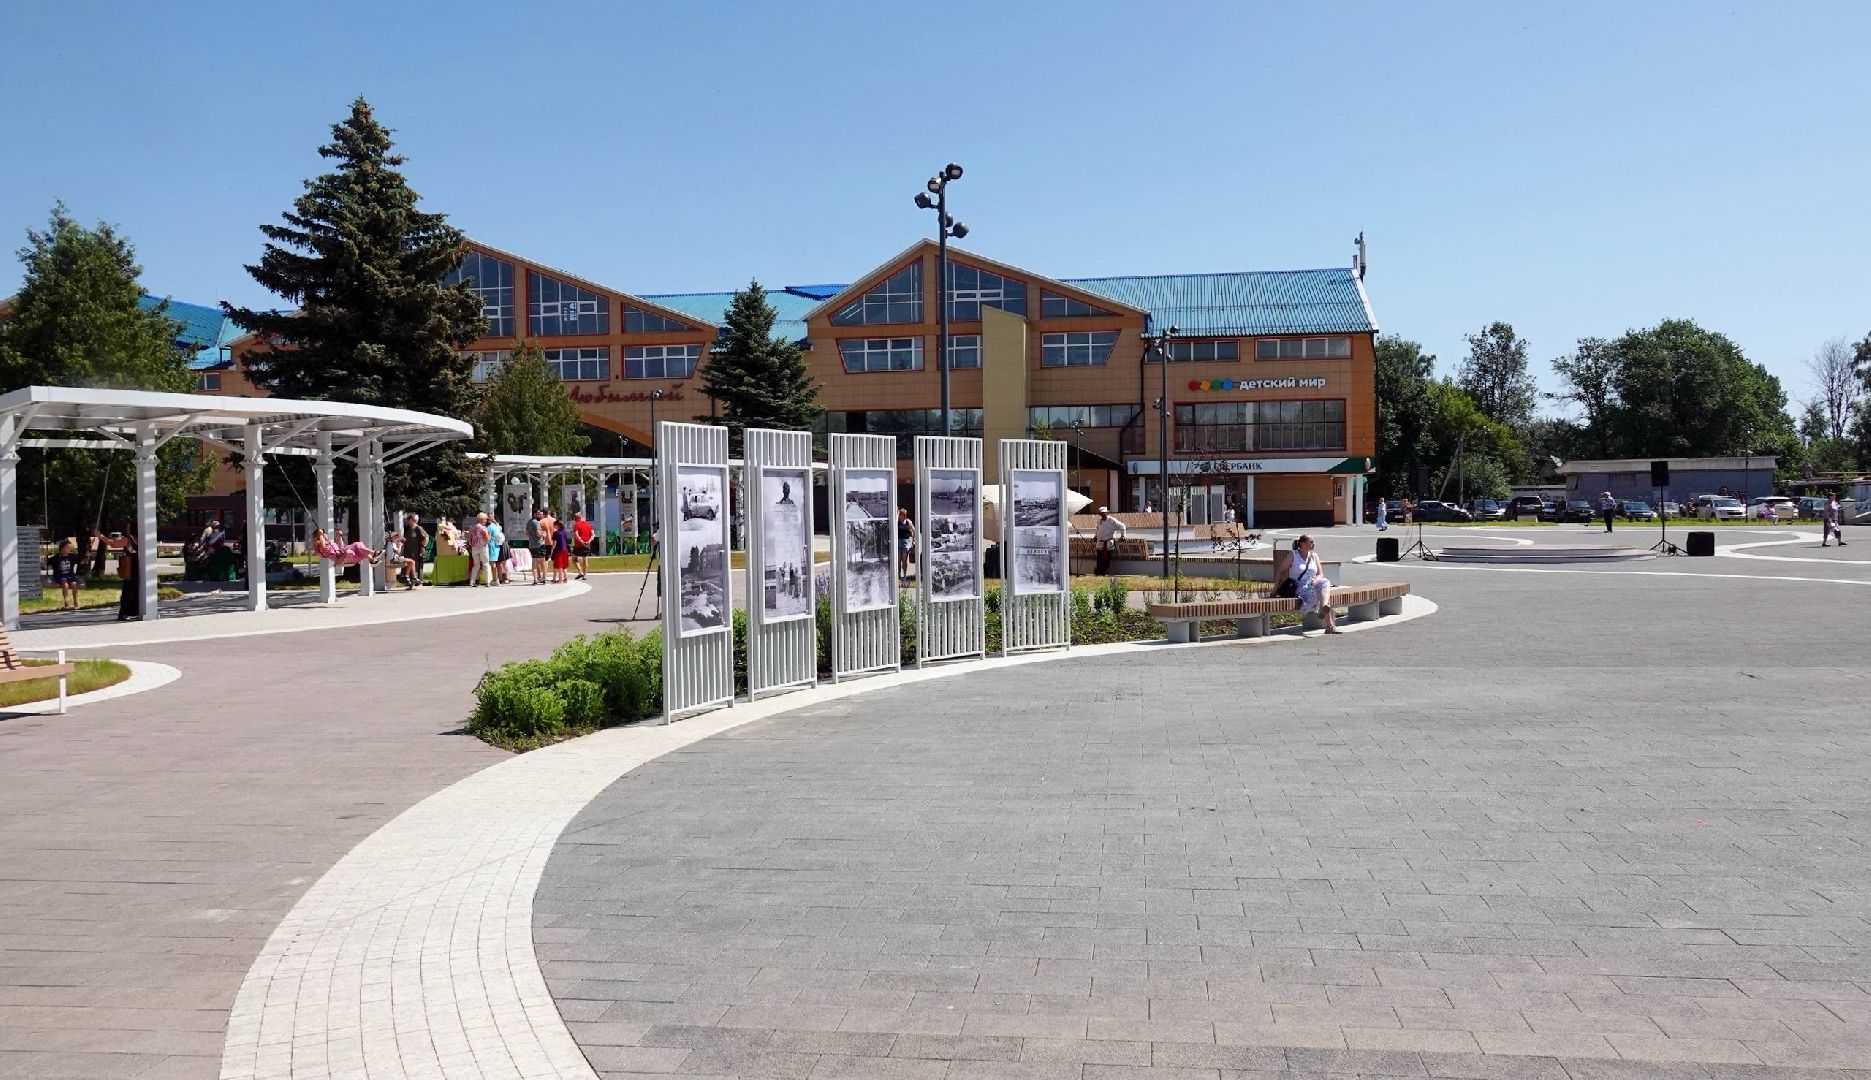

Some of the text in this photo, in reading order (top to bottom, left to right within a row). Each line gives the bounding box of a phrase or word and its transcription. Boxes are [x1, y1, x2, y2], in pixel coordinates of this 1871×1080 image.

[1239, 377, 1326, 390] детский мир
[1214, 462, 1263, 471] СЕРБАНК
